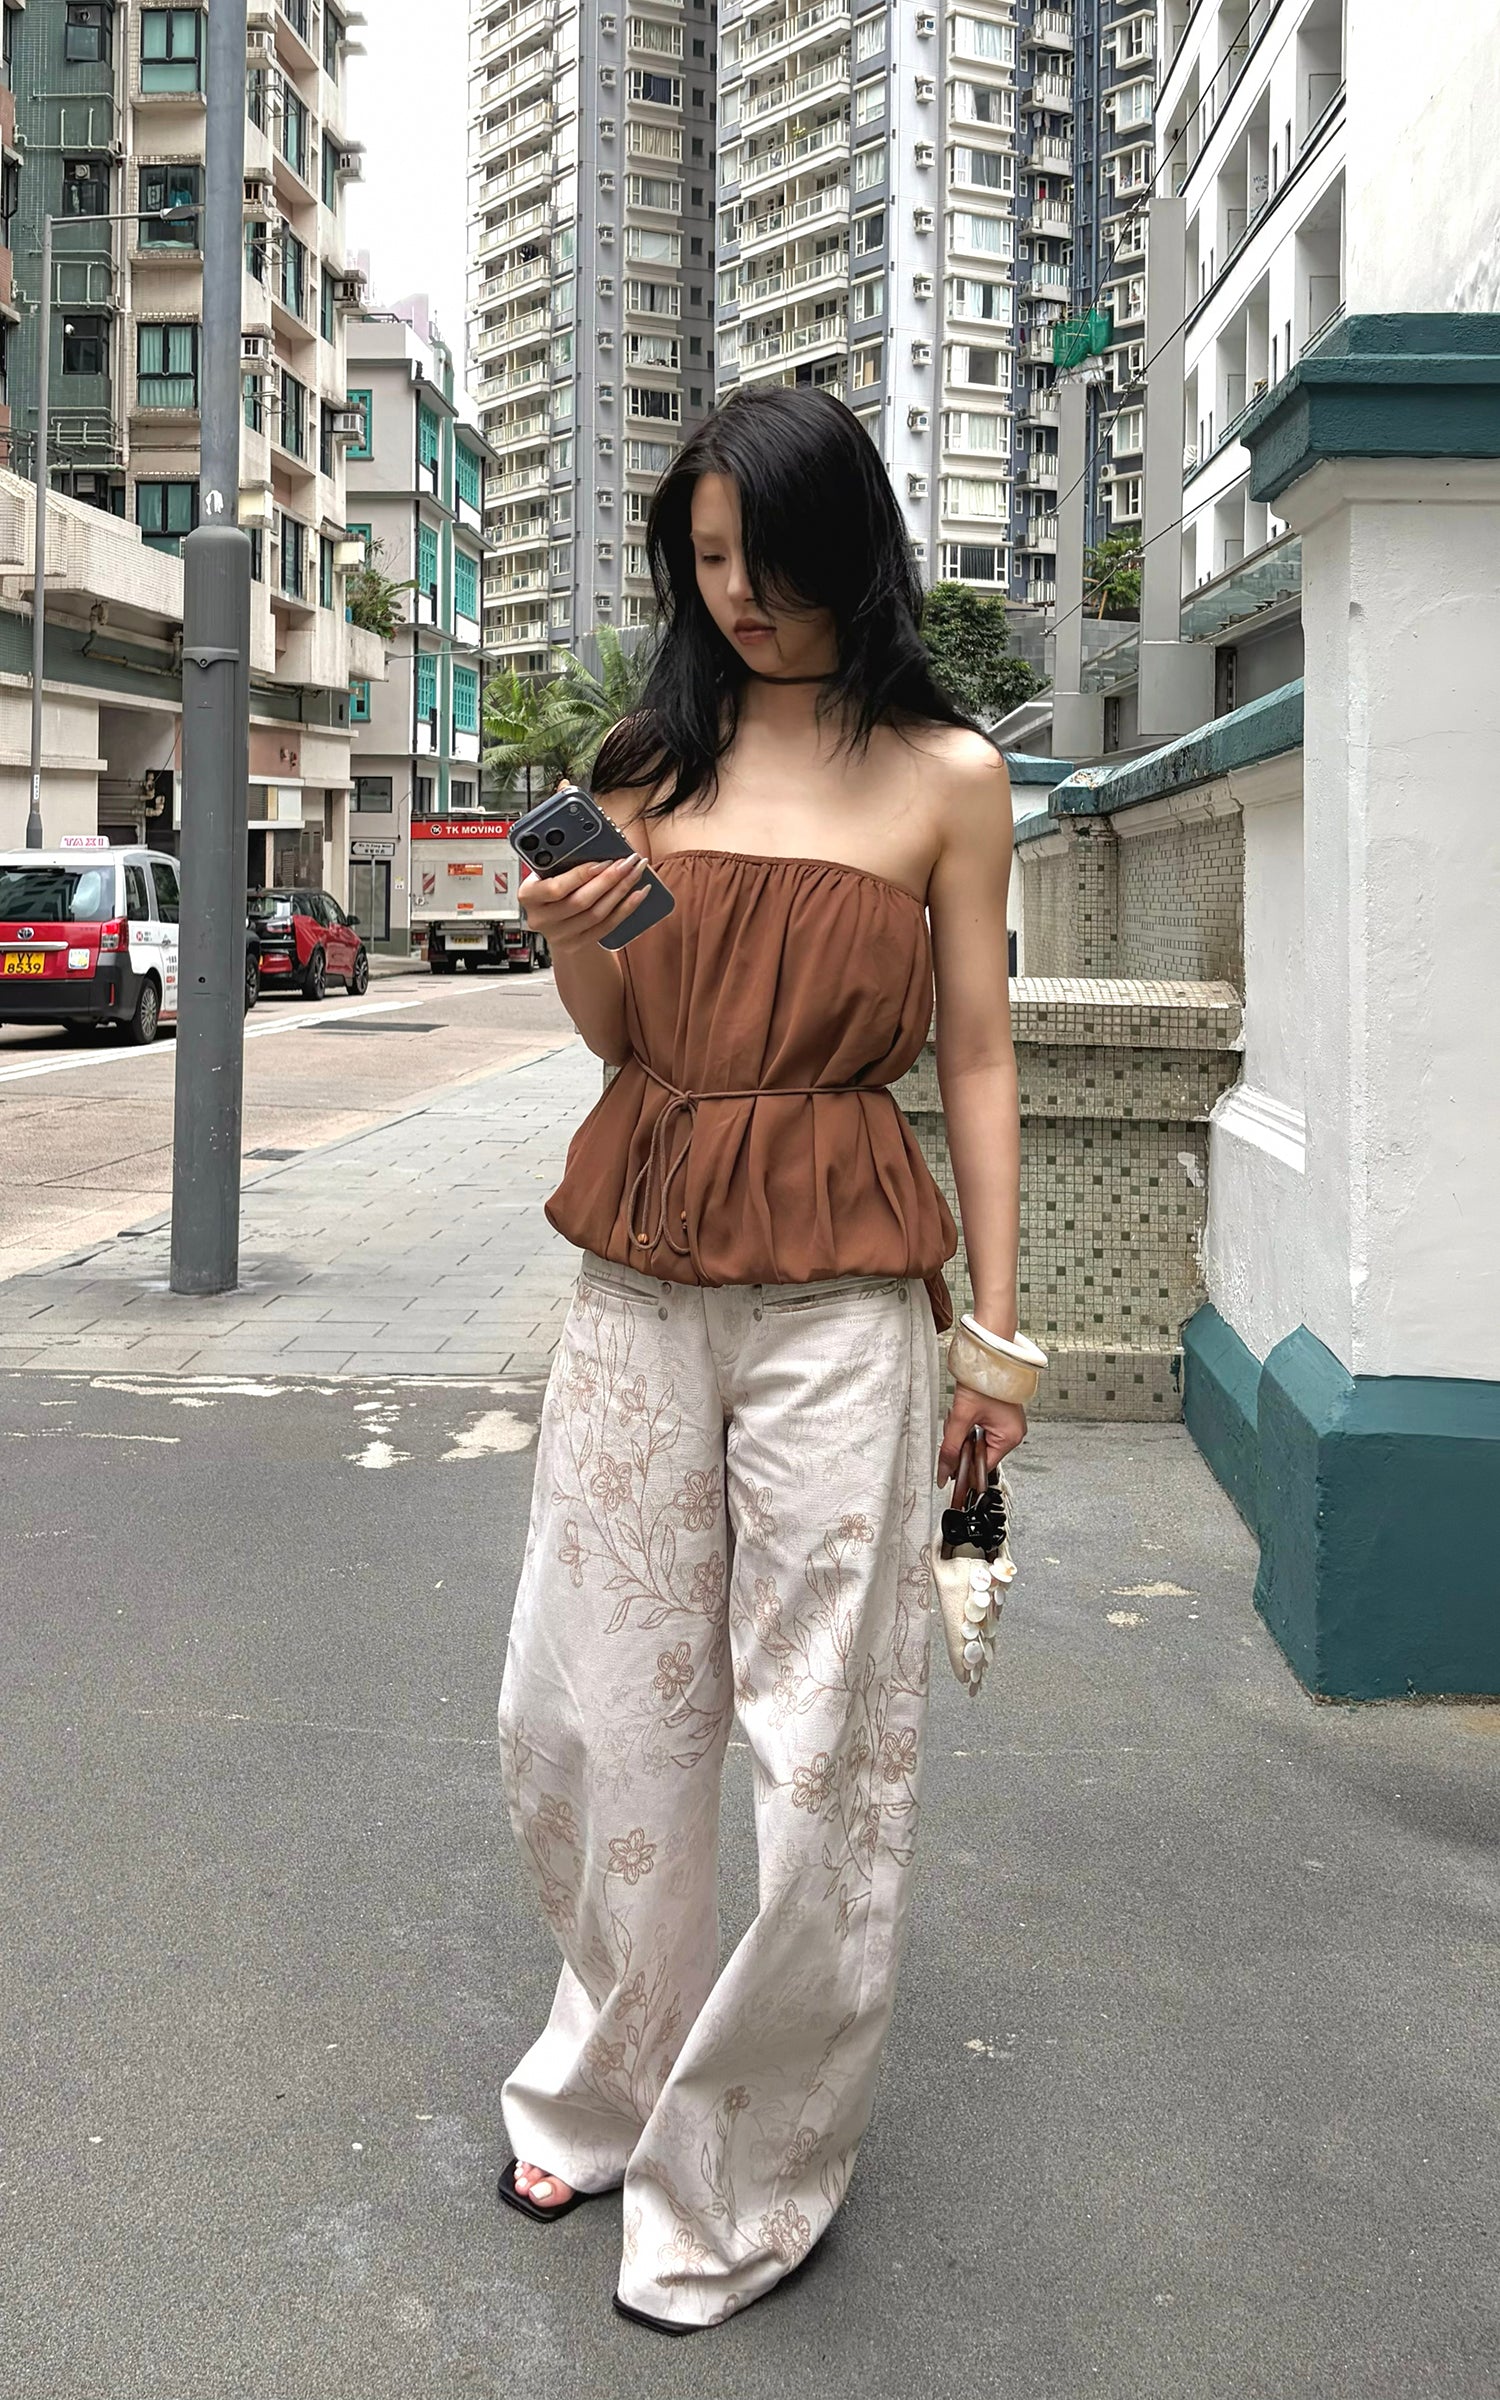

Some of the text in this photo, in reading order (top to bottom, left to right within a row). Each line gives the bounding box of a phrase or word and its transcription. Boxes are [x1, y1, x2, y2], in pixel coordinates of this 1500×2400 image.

[446, 825, 503, 834] TK MOVING
[64, 837, 104, 846] TAXI
[17, 952, 34, 963] VY
[7, 963, 42, 974] 8539
